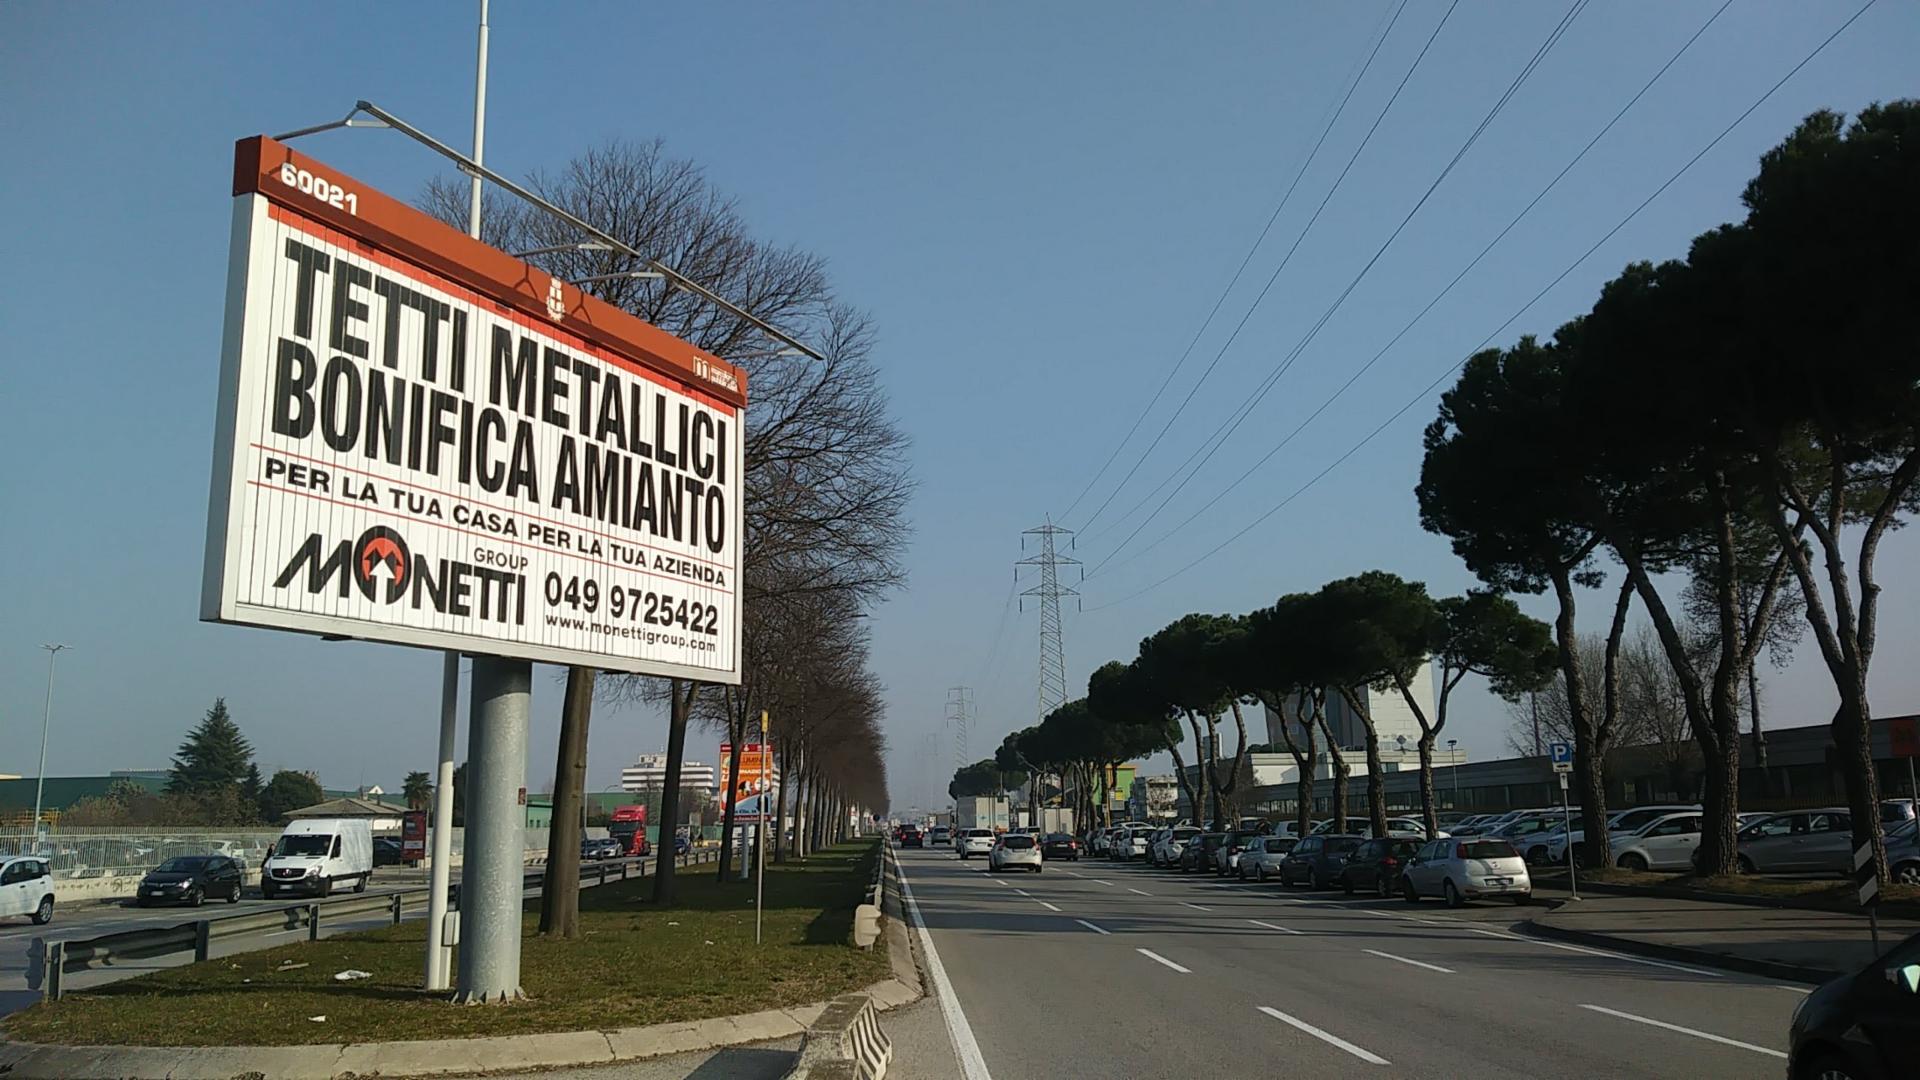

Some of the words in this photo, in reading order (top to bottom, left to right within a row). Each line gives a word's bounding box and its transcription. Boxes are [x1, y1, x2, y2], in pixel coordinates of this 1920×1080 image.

[281, 162, 358, 216] 60021
[285, 237, 468, 393] TETTI
[489, 323, 726, 486] METALLICI
[272, 337, 540, 504] BONIFICA
[551, 434, 725, 553] AMIANTO
[265, 457, 330, 493] PER
[342, 477, 379, 504] LA
[388, 488, 443, 519] TUA
[453, 505, 518, 537] CASA
[528, 523, 571, 549] PER
[578, 535, 603, 557] LA
[610, 543, 646, 567] TUA
[653, 555, 726, 586] AZIENDA
[272, 525, 527, 626] MONETTI
[474, 547, 529, 571] GROUP
[545, 571, 600, 614] 049
[610, 585, 718, 636] 9725422
[546, 614, 716, 652] www.monettigroup.com
[1553, 745, 1567, 761] P
